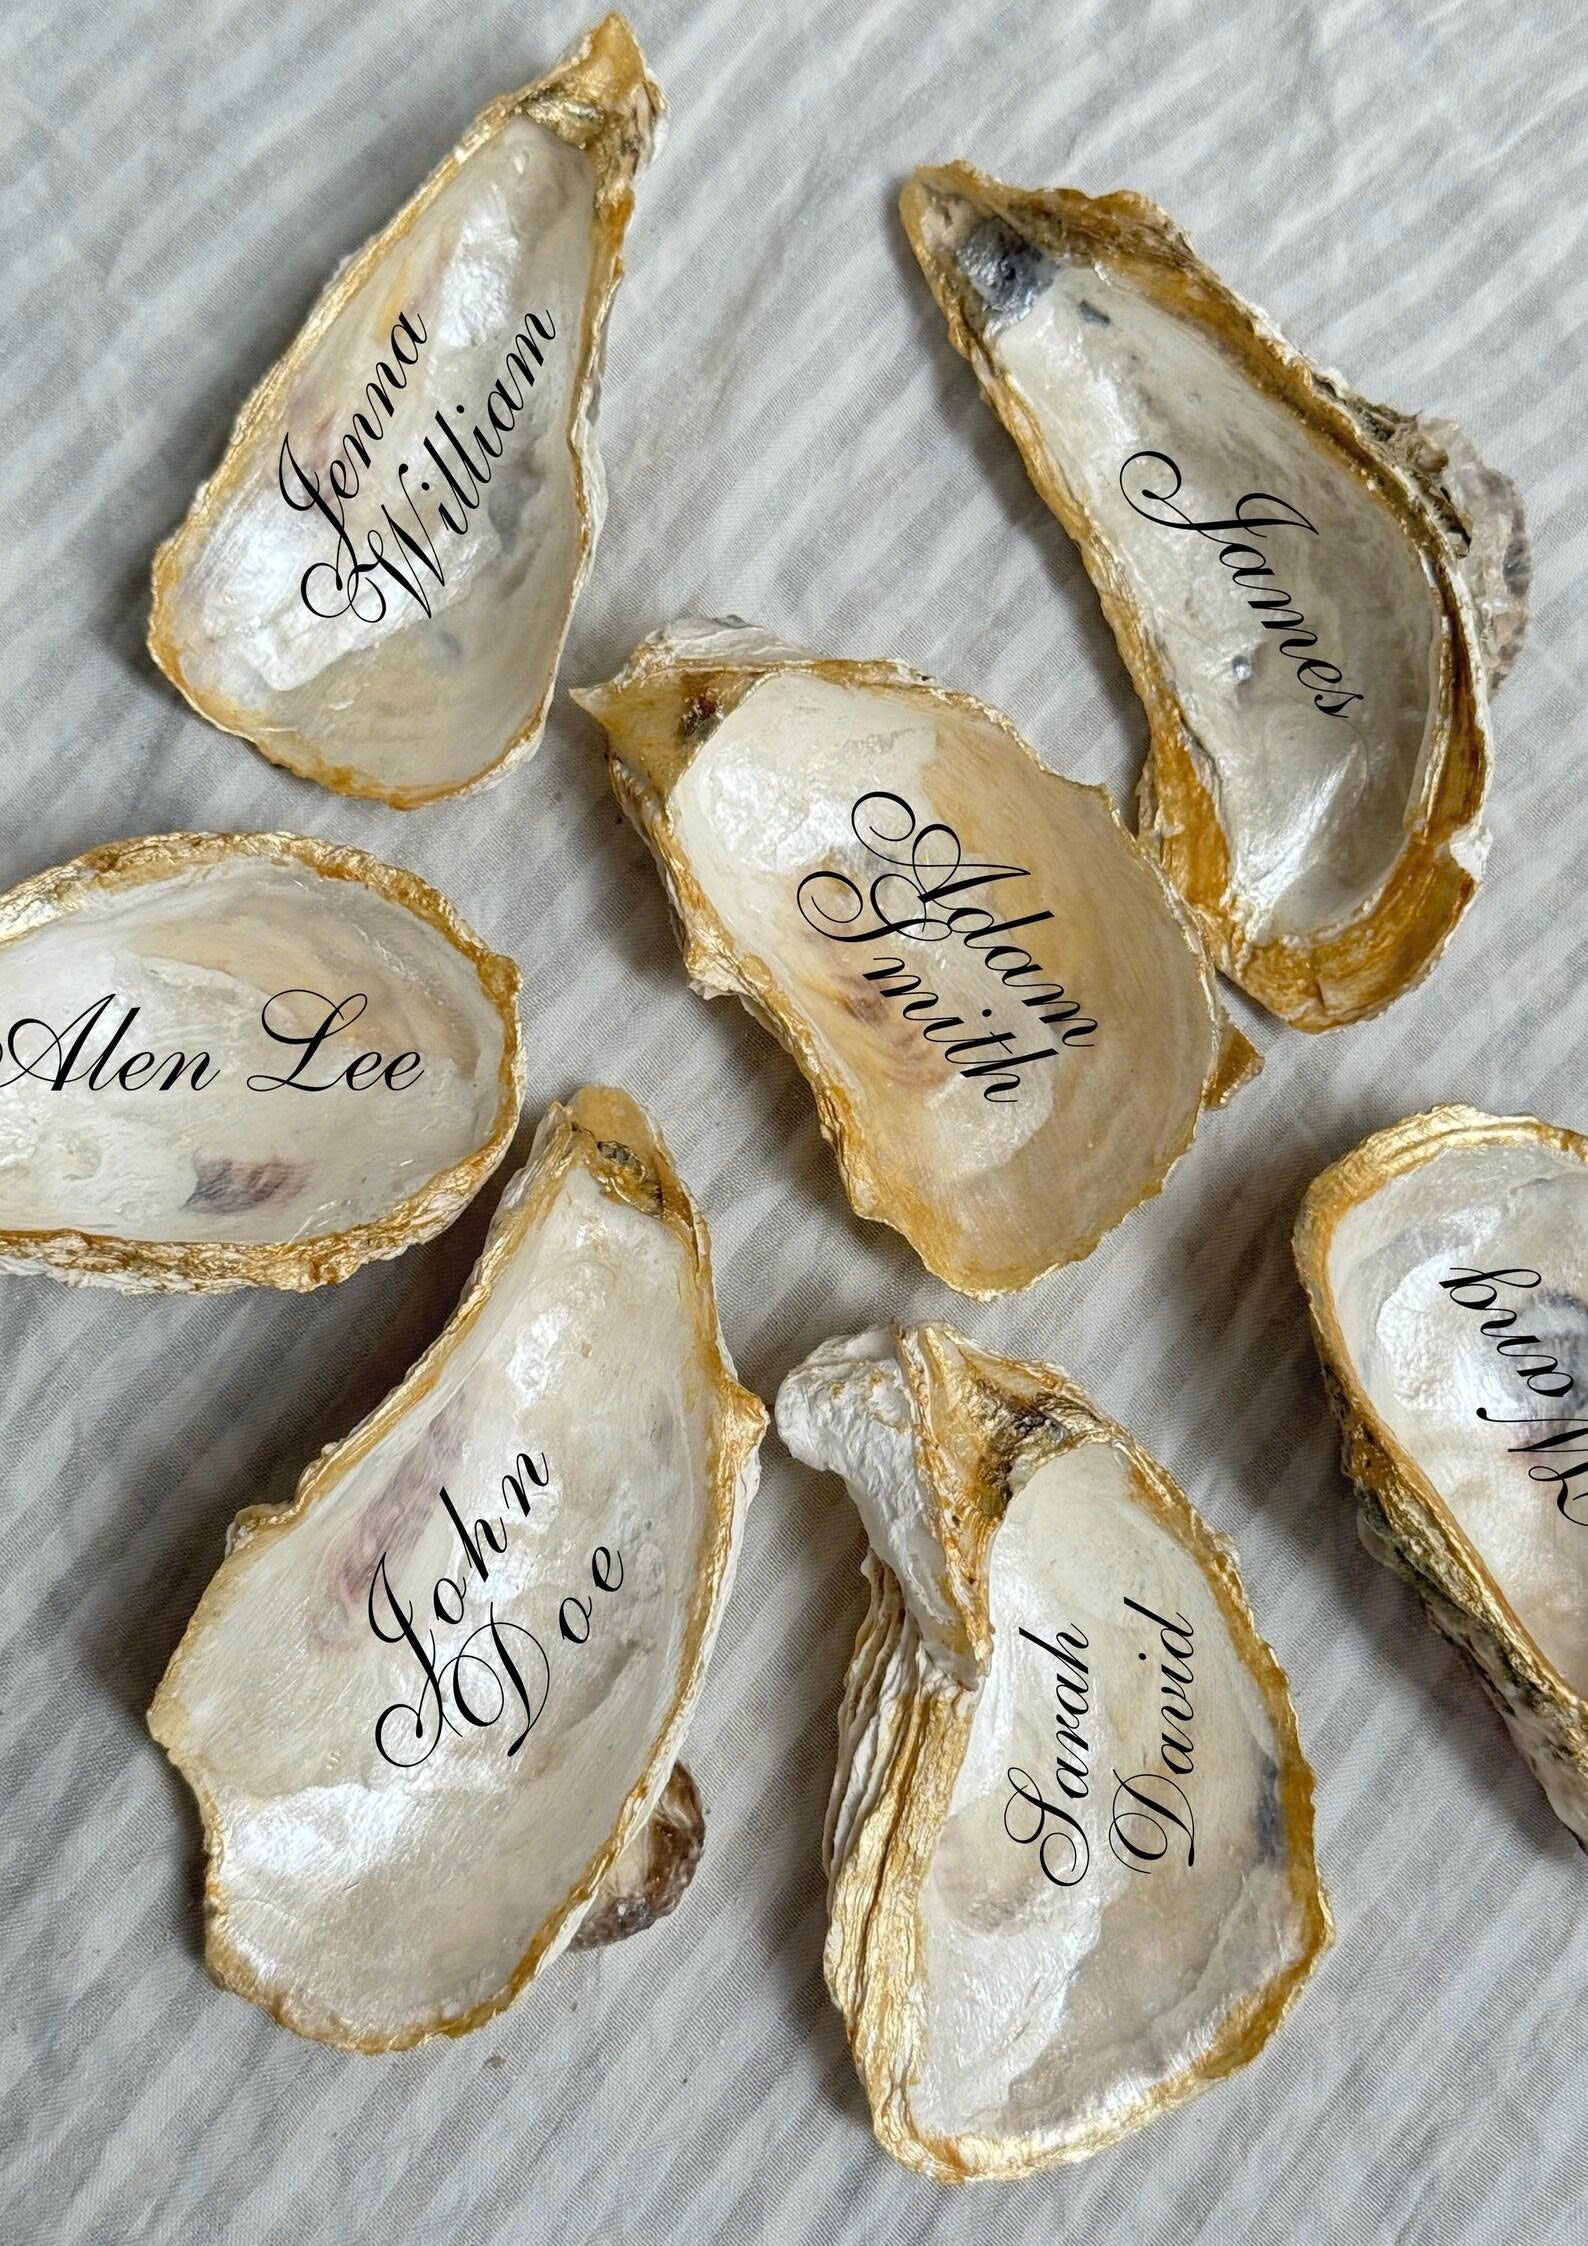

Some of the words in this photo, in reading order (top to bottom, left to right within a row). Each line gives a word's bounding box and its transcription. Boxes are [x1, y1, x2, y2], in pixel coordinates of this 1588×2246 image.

[279, 311, 428, 618] Jenna
[347, 309, 556, 623] William
[1119, 450, 1365, 719] James
[0, 993, 221, 1092] Alen
[246, 988, 425, 1092] Lee
[796, 870, 1060, 1103] Smith
[851, 790, 1099, 1048] Adam
[368, 1450, 550, 1768] John
[436, 1545, 625, 1758] Doe
[1108, 1596, 1195, 1874] David
[1003, 1622, 1090, 1887] Sarah
